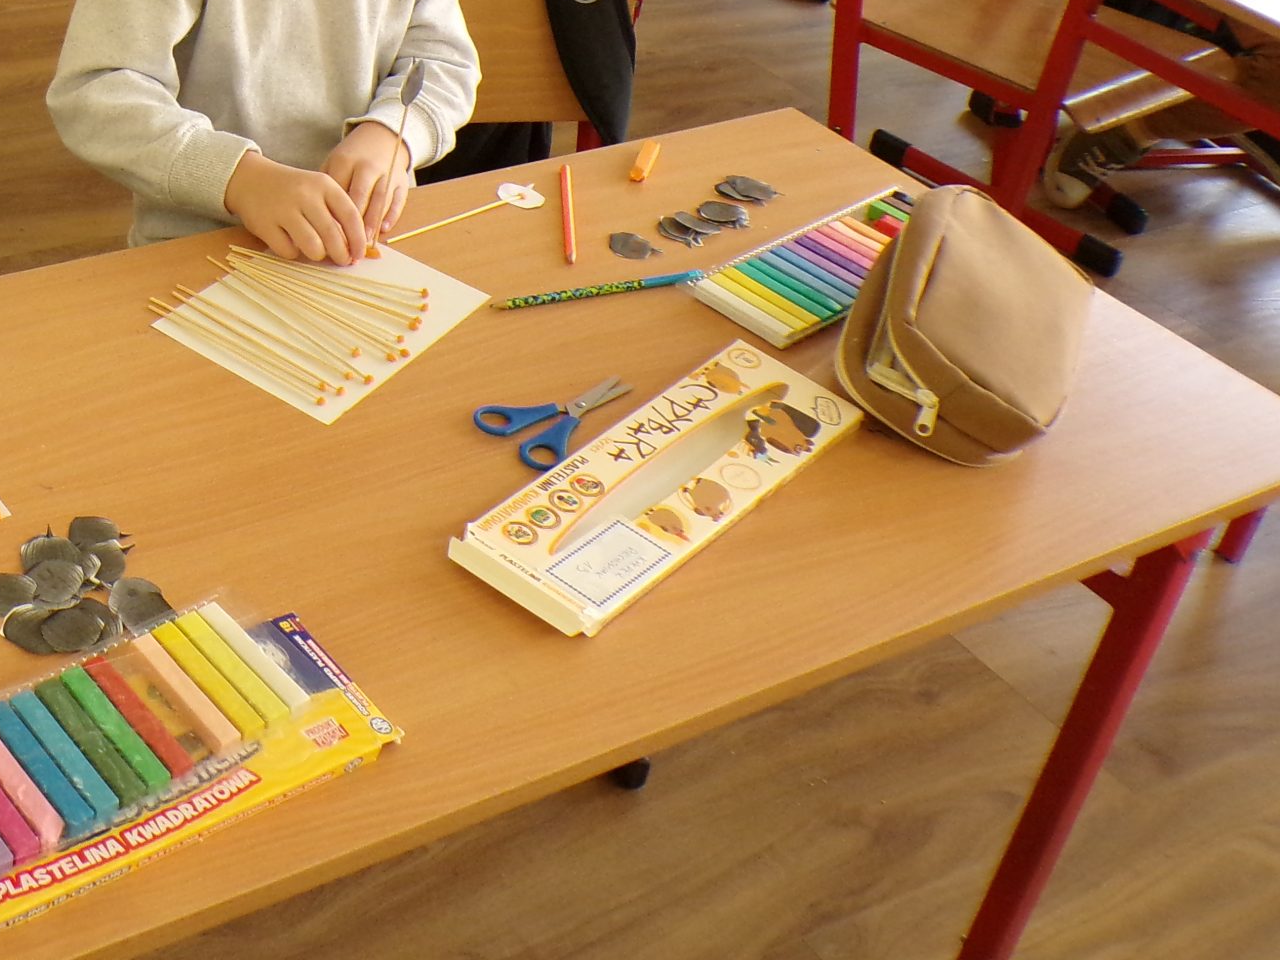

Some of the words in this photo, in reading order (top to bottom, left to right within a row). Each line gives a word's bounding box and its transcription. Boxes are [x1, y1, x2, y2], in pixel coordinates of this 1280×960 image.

[607, 383, 718, 462] CAPYBARA
[534, 454, 590, 493] PLASTELINA
[476, 487, 542, 534] KWADRATOWA
[124, 769, 259, 847] KWADRATOWA
